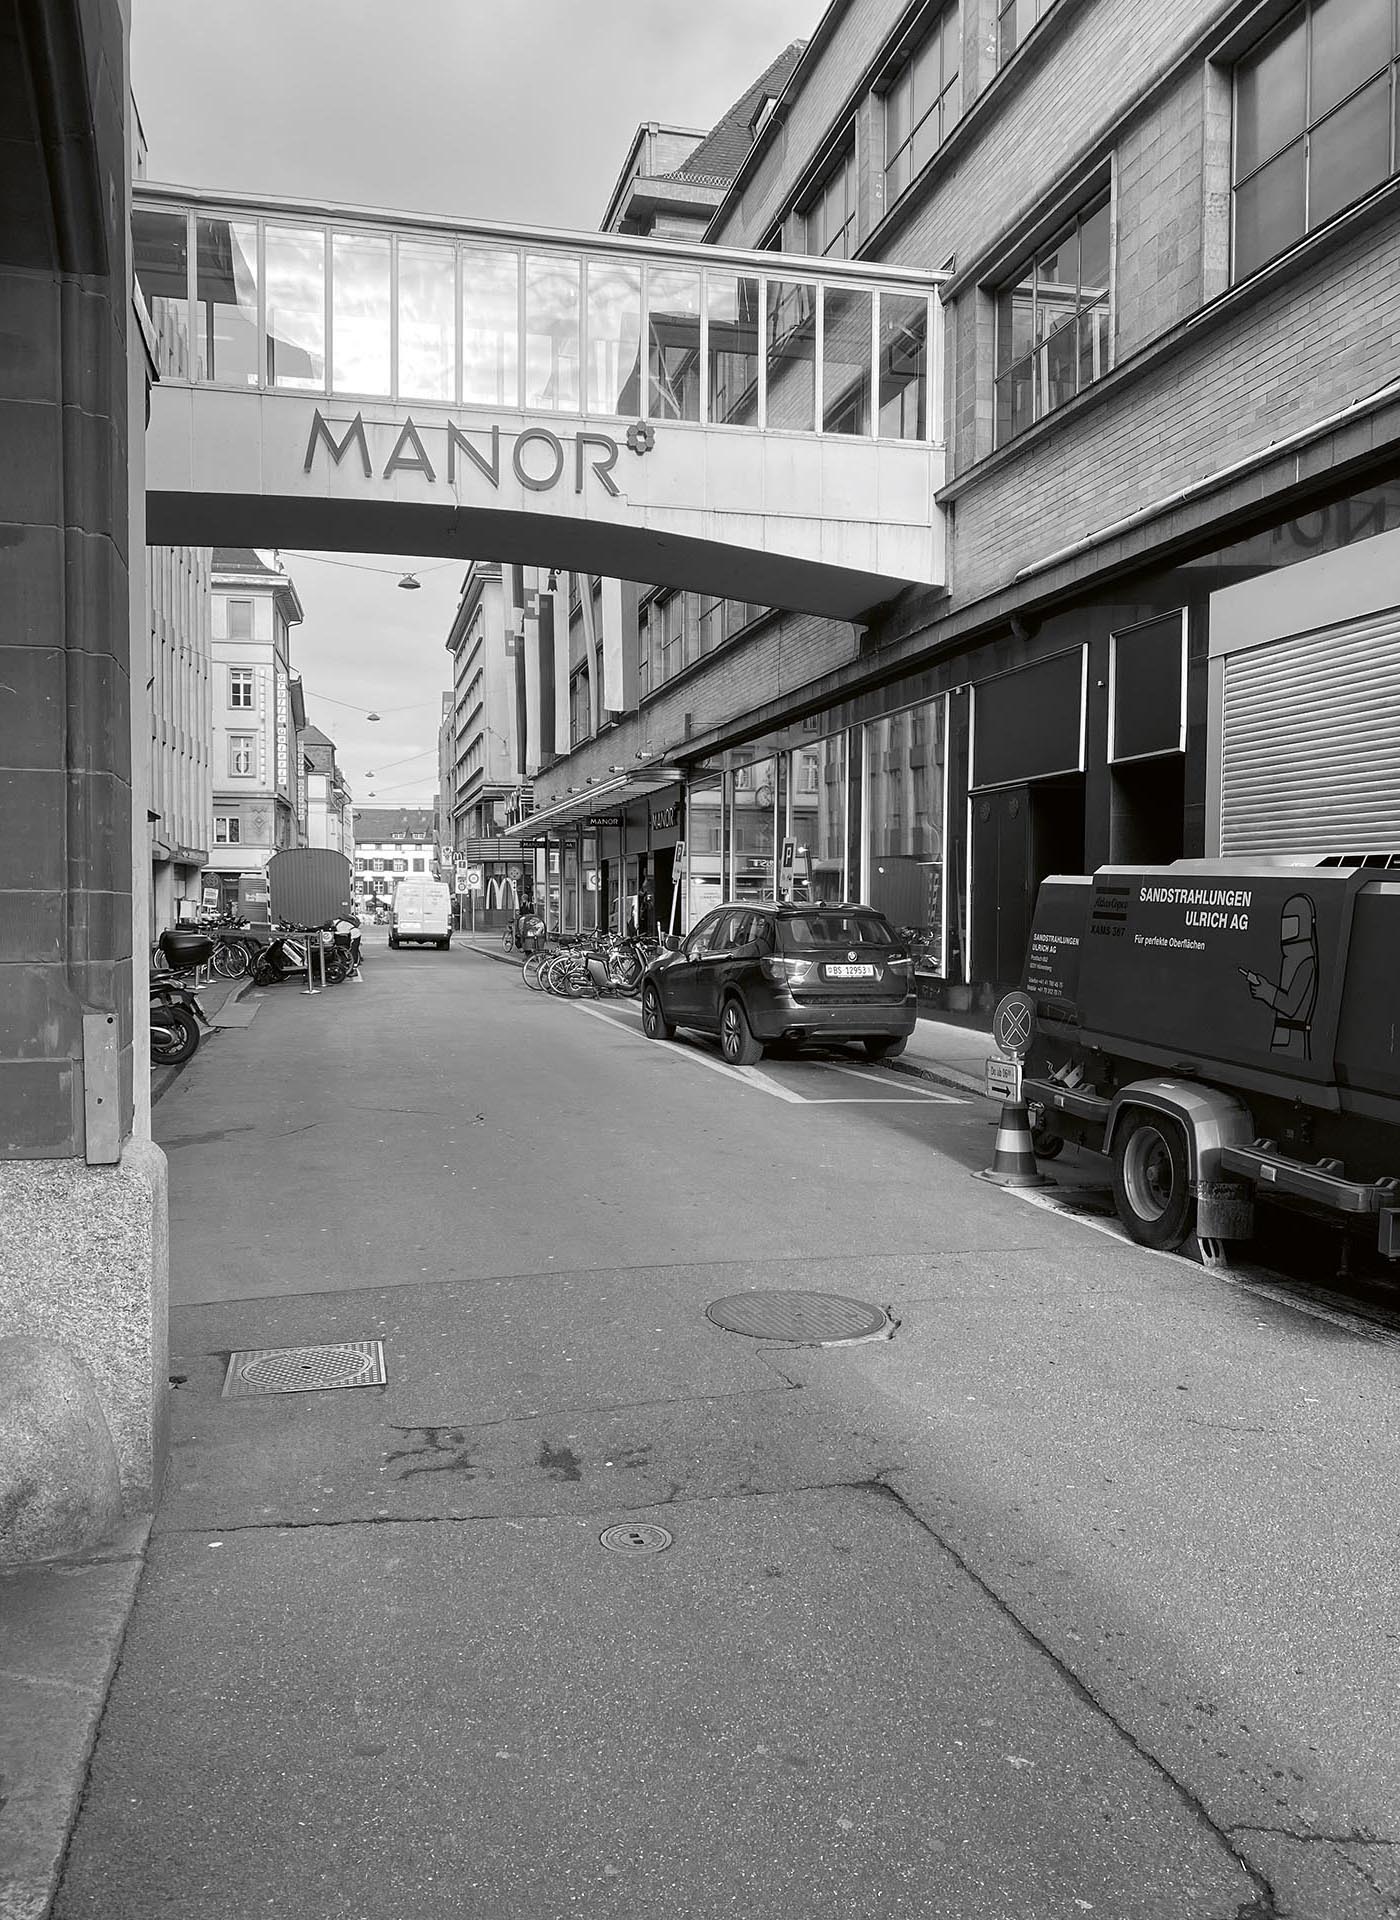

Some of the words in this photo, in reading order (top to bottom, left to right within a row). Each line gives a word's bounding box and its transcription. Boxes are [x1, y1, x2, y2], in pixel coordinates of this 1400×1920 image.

[303, 407, 621, 497] MANOR
[590, 817, 619, 826] MANOR
[652, 807, 674, 830] MANOR
[785, 847, 792, 865] P
[1139, 887, 1253, 907] SANDSTRAHLUNGEN
[1185, 911, 1227, 928] ULRICH
[1230, 914, 1249, 930] AG
[1033, 933, 1080, 946] SANDSTRAHLUNGEN
[1134, 934, 1144, 945] Für
[1144, 936, 1168, 947] perfekte
[1168, 937, 1206, 951] Oberflächen
[1032, 944, 1049, 953] ULRICH
[1049, 946, 1057, 954] AG
[833, 966, 843, 975] BS
[845, 966, 867, 975] 12953
